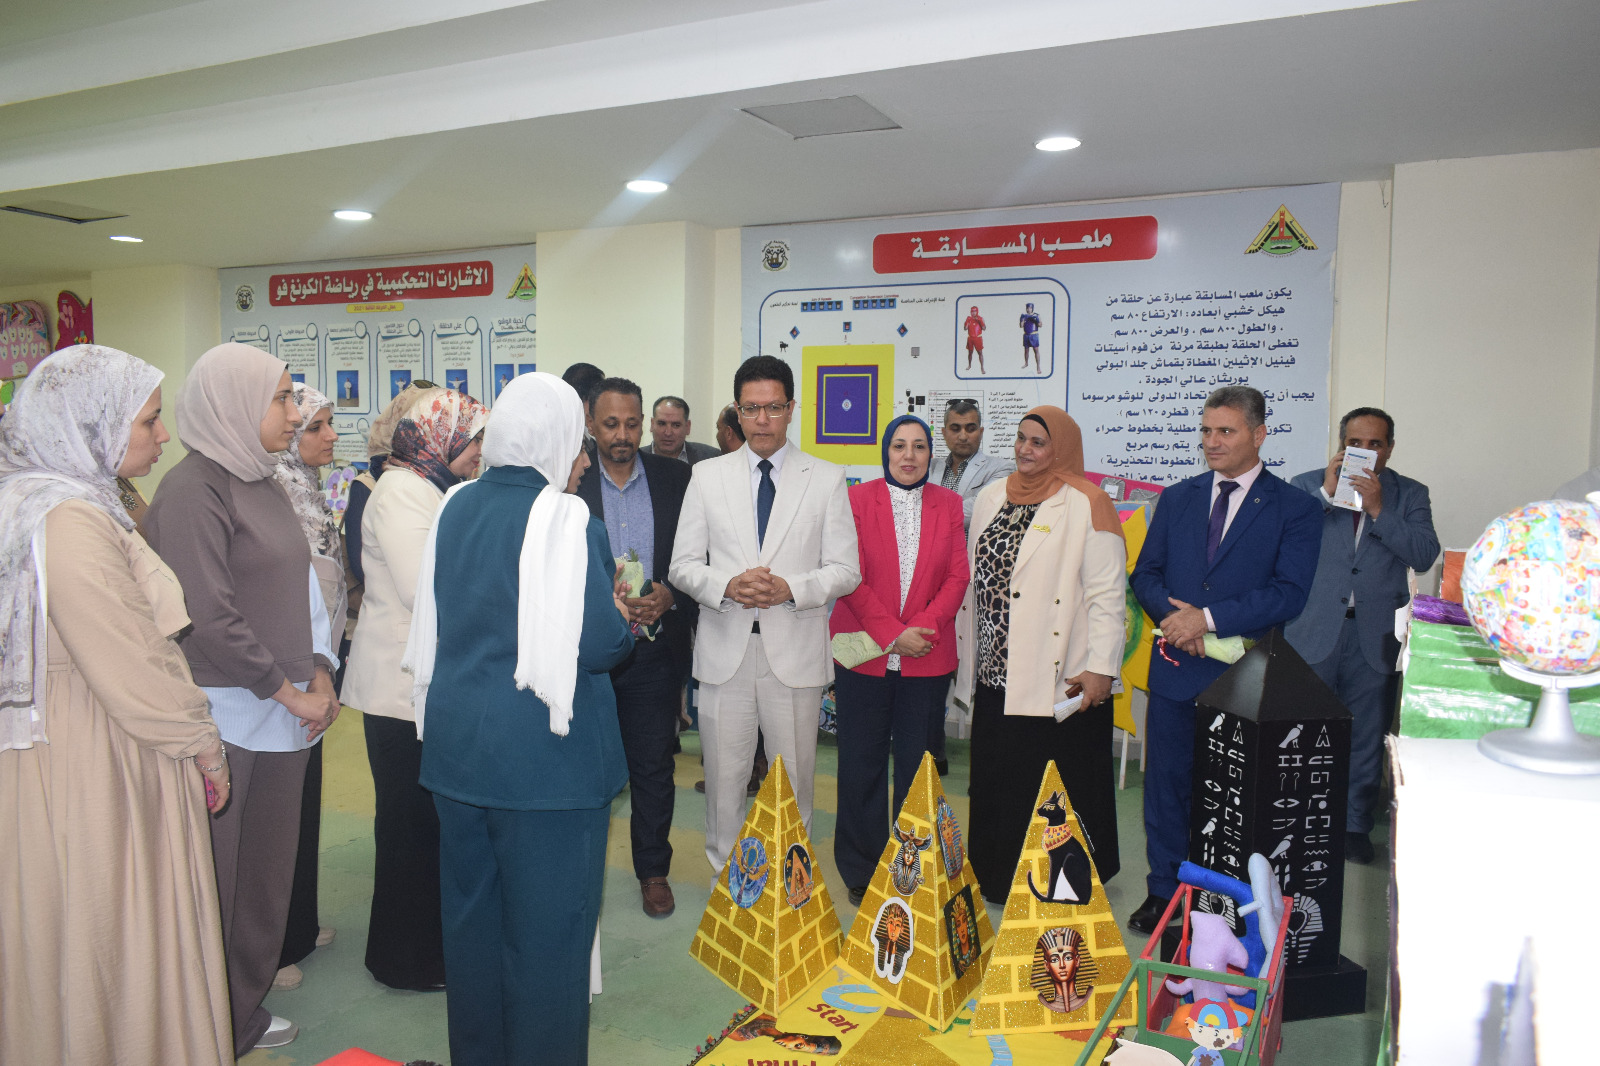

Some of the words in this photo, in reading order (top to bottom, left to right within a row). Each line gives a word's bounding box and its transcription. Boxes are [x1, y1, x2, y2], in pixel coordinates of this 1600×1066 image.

[910, 232, 1035, 264] المسابقة
[1041, 228, 1112, 258] ملعب
[377, 271, 433, 296] التحكيمية
[437, 265, 488, 291] الاشارات
[275, 279, 288, 300] فو
[290, 277, 322, 302] الكونغ
[325, 275, 359, 299] رياضة
[361, 273, 374, 300] في
[1120, 294, 1144, 303] حلقة
[1147, 294, 1162, 305] عن
[1164, 293, 1192, 304] عبارة
[1195, 290, 1236, 303] المسابقة
[1239, 290, 1263, 301] ملعب
[1266, 287, 1292, 300] يكون
[1106, 296, 1118, 307] من
[1141, 309, 1182, 322] الارتفاع
[1223, 305, 1254, 320] خشبي
[1258, 305, 1285, 317] هيكل
[1111, 314, 1125, 323] سم
[1150, 326, 1189, 337] والعرض
[1200, 327, 1215, 337] سم
[1238, 323, 1276, 335] والطول
[1094, 344, 1129, 355] أسيتات
[1131, 342, 1148, 354] فوم
[1150, 343, 1163, 354] من
[1170, 341, 1194, 353] مرنة
[1196, 340, 1229, 352] بطبقة
[1231, 339, 1265, 349] الحلقة
[1268, 338, 1299, 351] تغطى
[1096, 360, 1127, 373] البولي
[1130, 360, 1148, 370] جلد
[1151, 357, 1184, 370] بقماش
[1187, 357, 1221, 367] المغطاة
[1223, 356, 1262, 369] الإثيلين
[1265, 355, 1296, 368] فينيل
[1145, 375, 1178, 386] الجودة
[1180, 375, 1206, 388] عالي
[1209, 372, 1249, 386] يوريثان
[1082, 392, 1115, 403] مرسوما
[1117, 392, 1144, 402] للوشو
[1148, 392, 1181, 403] الدولى
[1277, 389, 1289, 401] أن
[1291, 392, 1315, 402] يجب
[1126, 410, 1140, 420] سم
[1161, 407, 1189, 419] قطره
[1095, 425, 1124, 435] حمراء
[1127, 424, 1164, 435] بخطوط
[1166, 423, 1197, 436] مطلية
[1126, 442, 1148, 452] مربع
[1151, 443, 1170, 453] رسم
[1172, 440, 1190, 452] يتم
[1106, 455, 1157, 467] التحذيرية
[1160, 456, 1200, 467] الخطوط
[1265, 457, 1286, 468] خطو
[1150, 473, 1166, 485] سم
